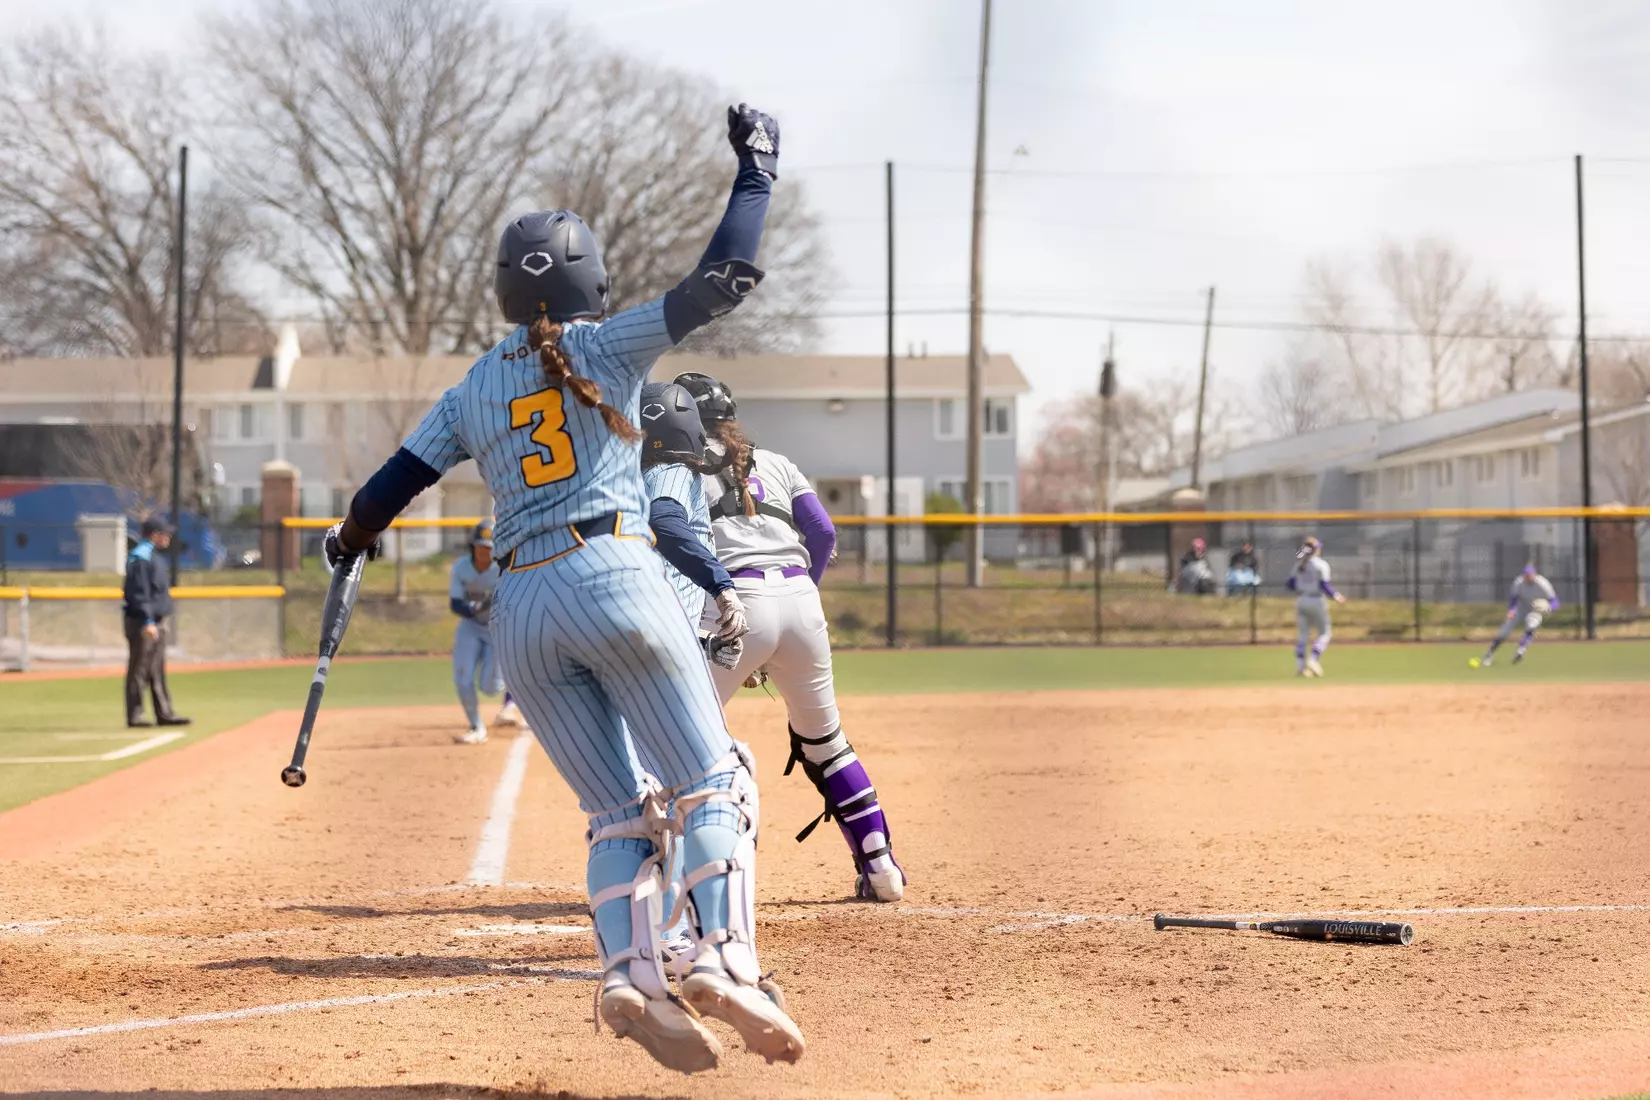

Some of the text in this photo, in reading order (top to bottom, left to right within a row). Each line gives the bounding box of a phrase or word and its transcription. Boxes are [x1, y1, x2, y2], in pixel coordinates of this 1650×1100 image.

[509, 387, 577, 488] 3
[653, 440, 663, 449] 23
[1323, 922, 1383, 936] LOUISVILLE
